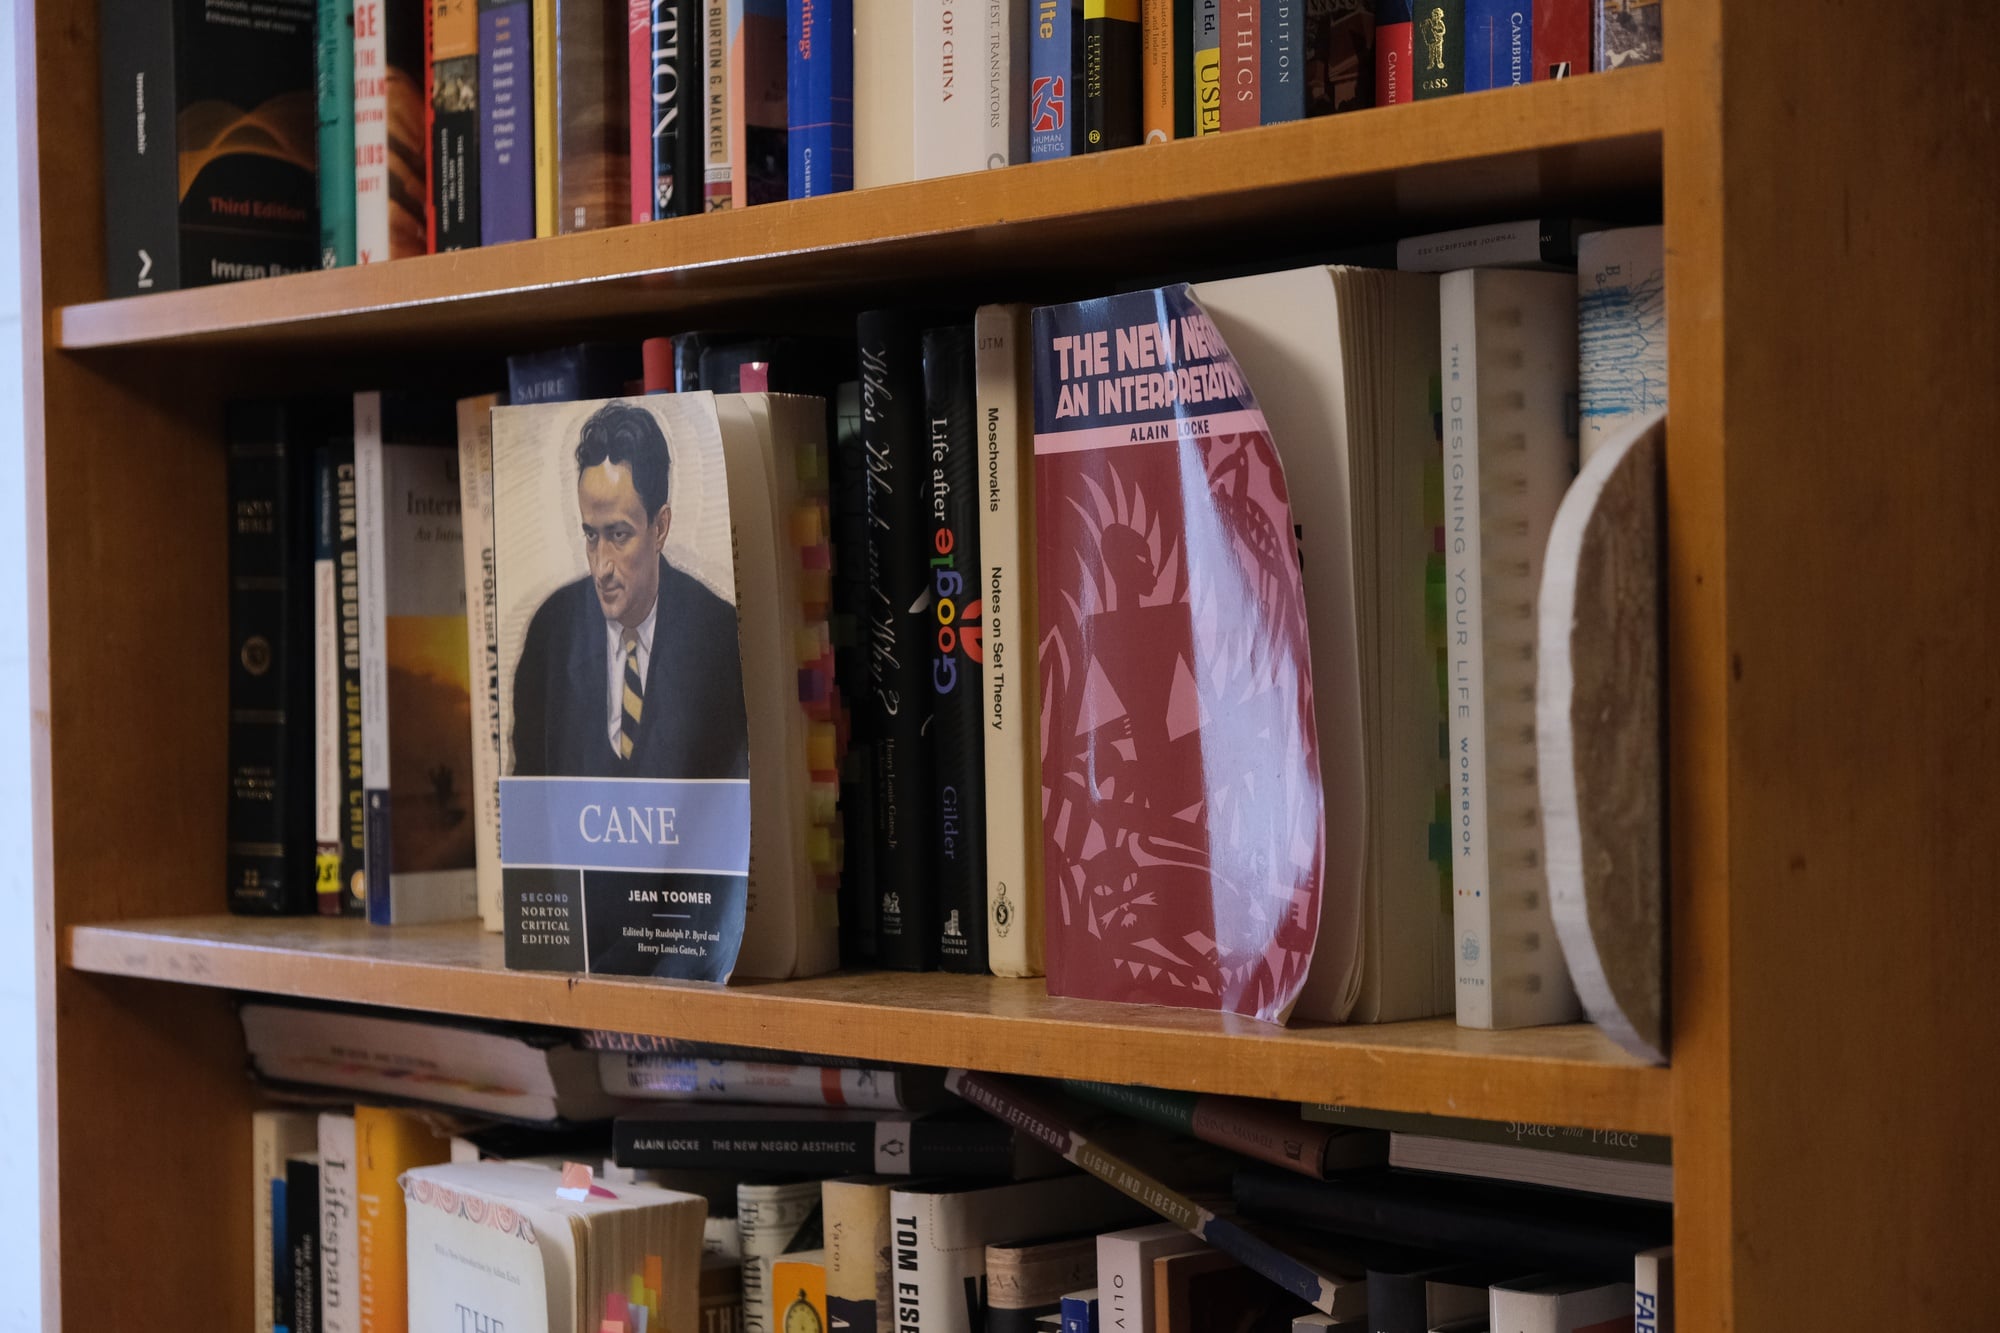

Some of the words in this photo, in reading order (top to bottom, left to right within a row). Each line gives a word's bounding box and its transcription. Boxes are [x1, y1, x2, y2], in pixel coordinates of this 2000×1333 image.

[709, 7, 722, 68] BURTON
[941, 10, 954, 35] OF
[1204, 14, 1216, 36] Ed.
[941, 40, 955, 103] CHINA
[1087, 35, 1095, 98] CLASSICS
[1093, 35, 1101, 97] LITERARY
[1236, 0, 1255, 102] THICS
[709, 74, 721, 90] G.
[990, 32, 1001, 129] TRANSLATORS
[1421, 77, 1449, 90] CASS
[709, 94, 723, 157] MALKIEL
[1031, 142, 1065, 154] KINETICS
[1033, 133, 1063, 144] HUMAN
[209, 197, 250, 217] Third
[253, 201, 306, 221] Edition
[1435, 238, 1478, 255] SCRIPTURE
[1480, 232, 1518, 246] JOURNAL
[211, 258, 266, 281] Imran
[979, 336, 1004, 351] UTM
[1052, 331, 1110, 381] THE
[1115, 319, 1177, 372] NEW
[1450, 343, 1460, 382] THE
[517, 377, 566, 401] SAFIRE
[862, 344, 893, 424] Who's
[1056, 381, 1089, 419] AN
[931, 417, 951, 462] Life
[1130, 424, 1169, 442] ALAIN
[1178, 419, 1210, 438] LOCKE
[987, 407, 1001, 513] Moschovakis
[1450, 395, 1467, 555] DESIGNING
[337, 464, 355, 541] CHINA
[865, 440, 893, 530] Black
[932, 467, 952, 521] after
[481, 548, 493, 606] UPON
[868, 536, 891, 604] and
[990, 566, 1003, 613] Notes
[340, 551, 360, 669] UNBOUND
[929, 527, 963, 695] Google
[992, 617, 1003, 638] on
[1454, 567, 1469, 647] YOUR
[992, 642, 1004, 669] Set
[992, 672, 1005, 731] Theory
[1456, 660, 1471, 720] LIFE
[887, 738, 898, 770] Henry
[887, 774, 898, 803] Louis
[1459, 736, 1472, 857] WORKBOOK
[578, 804, 680, 845] CANE
[942, 784, 959, 861] Gilder
[520, 892, 570, 903] SECOND
[520, 906, 570, 917] NORTON
[628, 890, 658, 902] JEAN
[661, 890, 712, 905] TOOMER
[520, 920, 571, 932] CRITICAL
[521, 934, 571, 946] EDITION
[622, 926, 644, 938] Edited
[645, 927, 655, 941] by
[655, 928, 685, 940] Rudolph
[684, 931, 692, 940] P.
[692, 931, 708, 943] Byrd
[708, 932, 720, 942] and
[637, 942, 660, 955] Henry
[660, 943, 679, 955] Louis
[679, 945, 698, 957] Gates,
[698, 946, 708, 958] Jr.
[1459, 976, 1485, 986] POTTER
[963, 1078, 1003, 1109] THOMAS
[1005, 1101, 1065, 1150] JEFFERSON
[1505, 1120, 1557, 1142] Space
[1560, 1126, 1584, 1138] and
[1591, 1129, 1639, 1149] Place
[633, 1139, 664, 1150] ALAIN
[667, 1139, 701, 1151] LOCKE
[712, 1140, 731, 1150] THE
[733, 1141, 758, 1151] NEW
[761, 1142, 799, 1153] NEGRO
[801, 1142, 857, 1154] AESTHETIC
[1082, 1150, 1117, 1181] LIGHT
[1118, 1171, 1141, 1195] AND
[1143, 1185, 1192, 1224] LIBERTY
[321, 1158, 349, 1308] Lifespan
[832, 1219, 843, 1273] Varon
[895, 1215, 918, 1272] TOM
